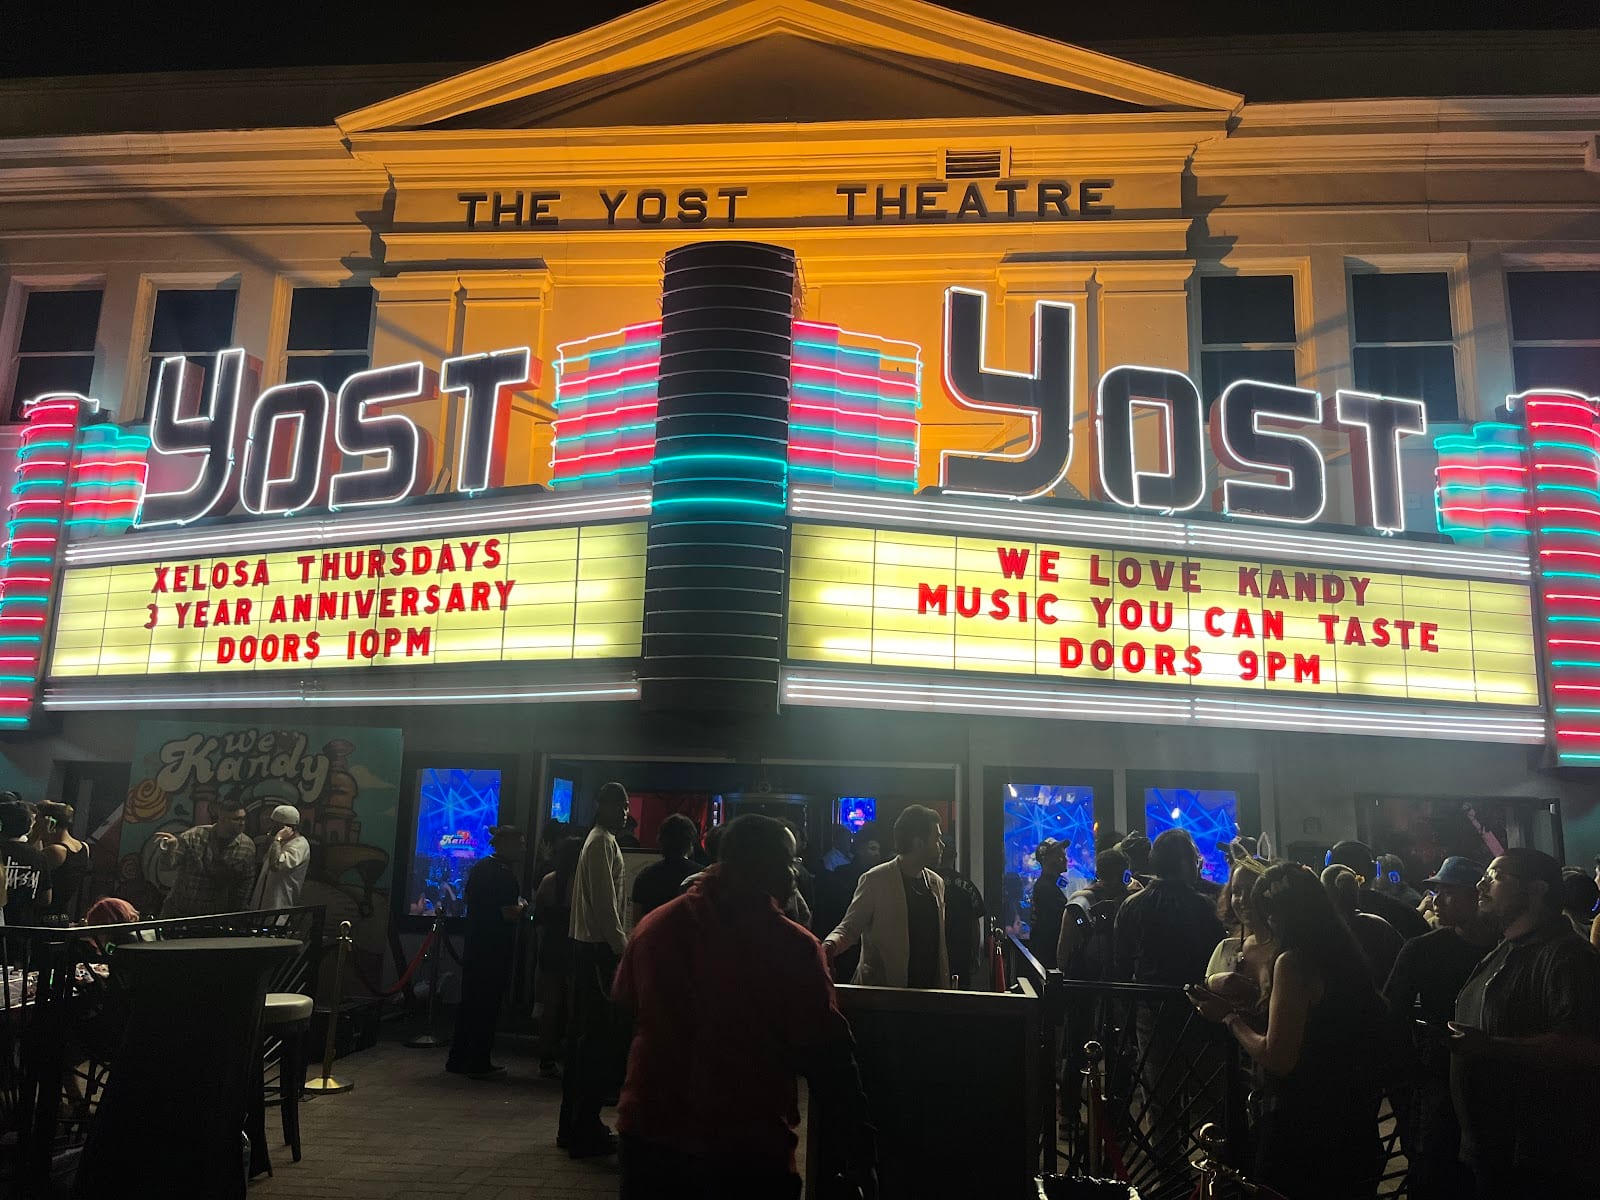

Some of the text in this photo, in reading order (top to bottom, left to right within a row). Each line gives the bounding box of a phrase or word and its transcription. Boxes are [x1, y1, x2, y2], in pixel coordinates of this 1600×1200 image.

[457, 179, 1116, 227] THE YOST THEATRE
[133, 347, 532, 528] YOST
[939, 286, 1427, 536] YOST
[151, 538, 503, 594] XELOSA THURSDAYS
[997, 547, 1371, 607] WE LOVE KANDY
[143, 580, 515, 630] 3 YEAR ANNIVERSARY
[917, 582, 1439, 654] MUSIC YOU CAN TASTE
[216, 631, 321, 665] DOORS
[1058, 636, 1322, 685] DOORS 9PM
[156, 734, 330, 803] Kandy
